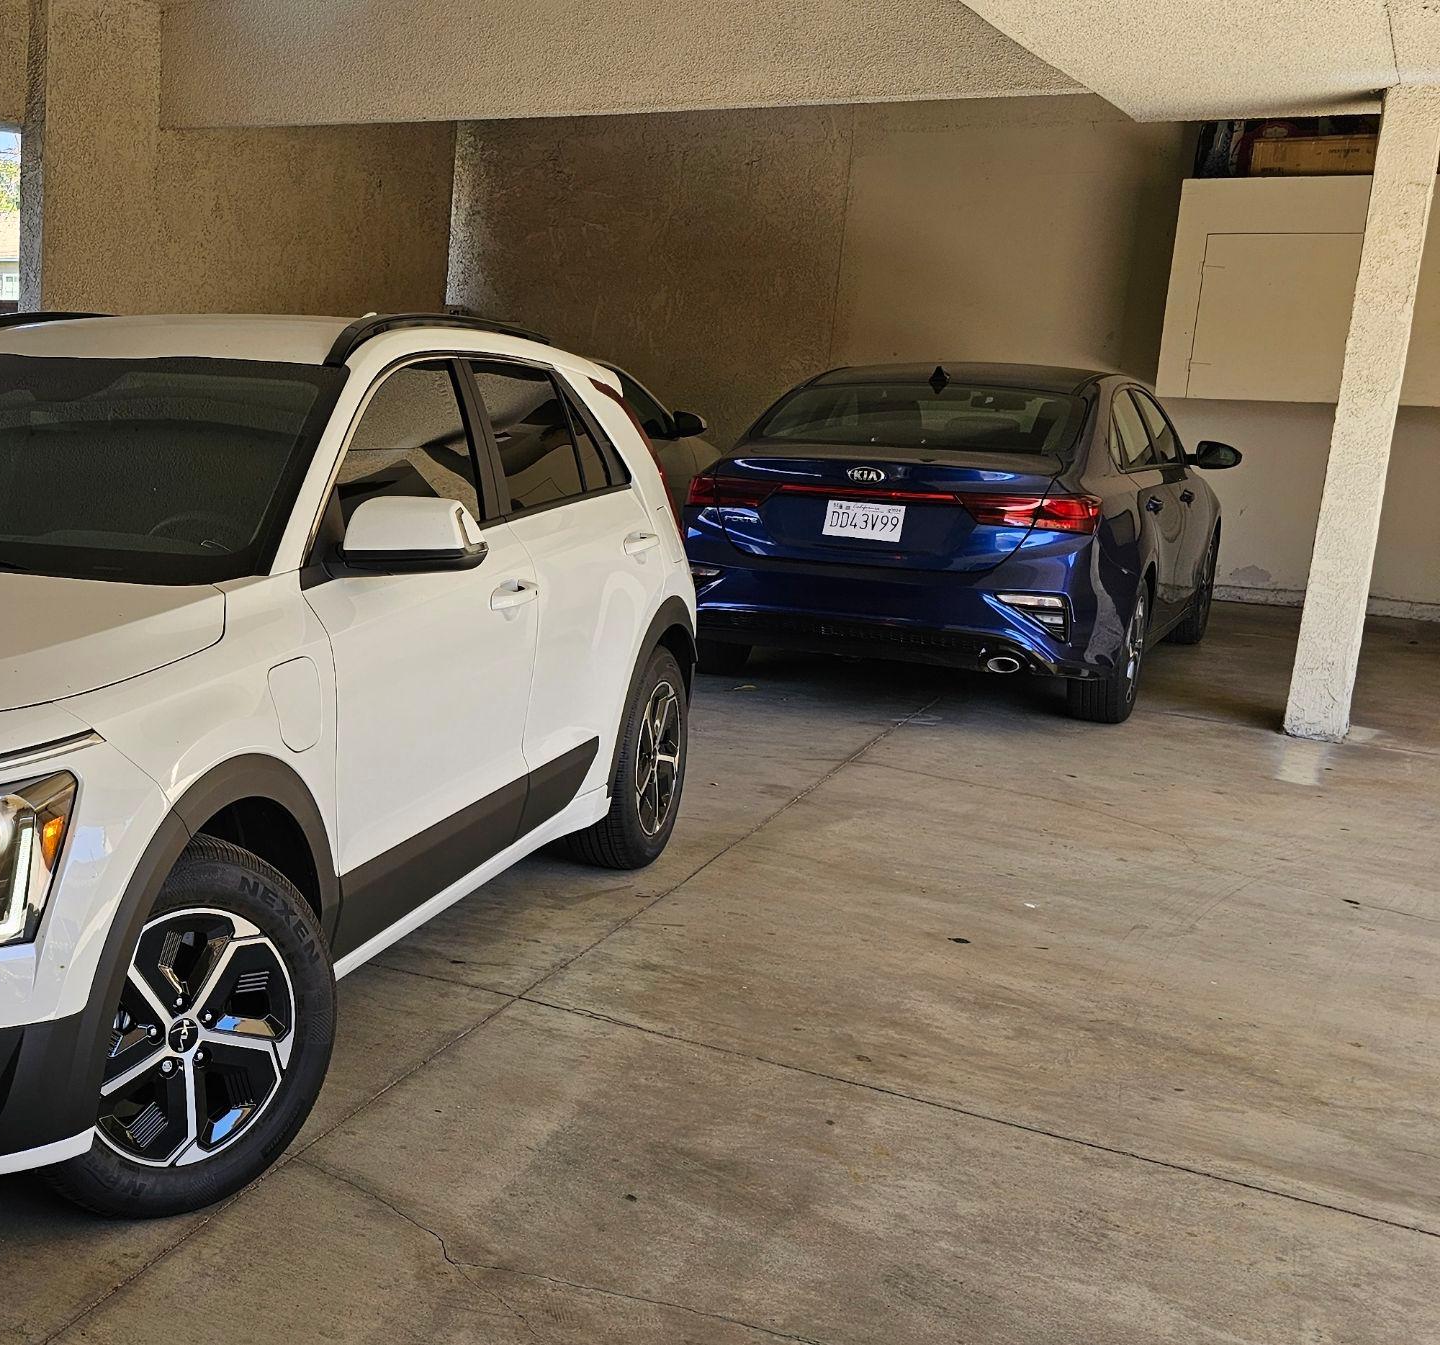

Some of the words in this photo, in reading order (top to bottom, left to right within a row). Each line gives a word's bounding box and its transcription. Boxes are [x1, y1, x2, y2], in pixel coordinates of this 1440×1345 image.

[852, 470, 878, 481] KIA
[829, 510, 899, 533] DD43V99
[238, 876, 320, 963] NEXEN
